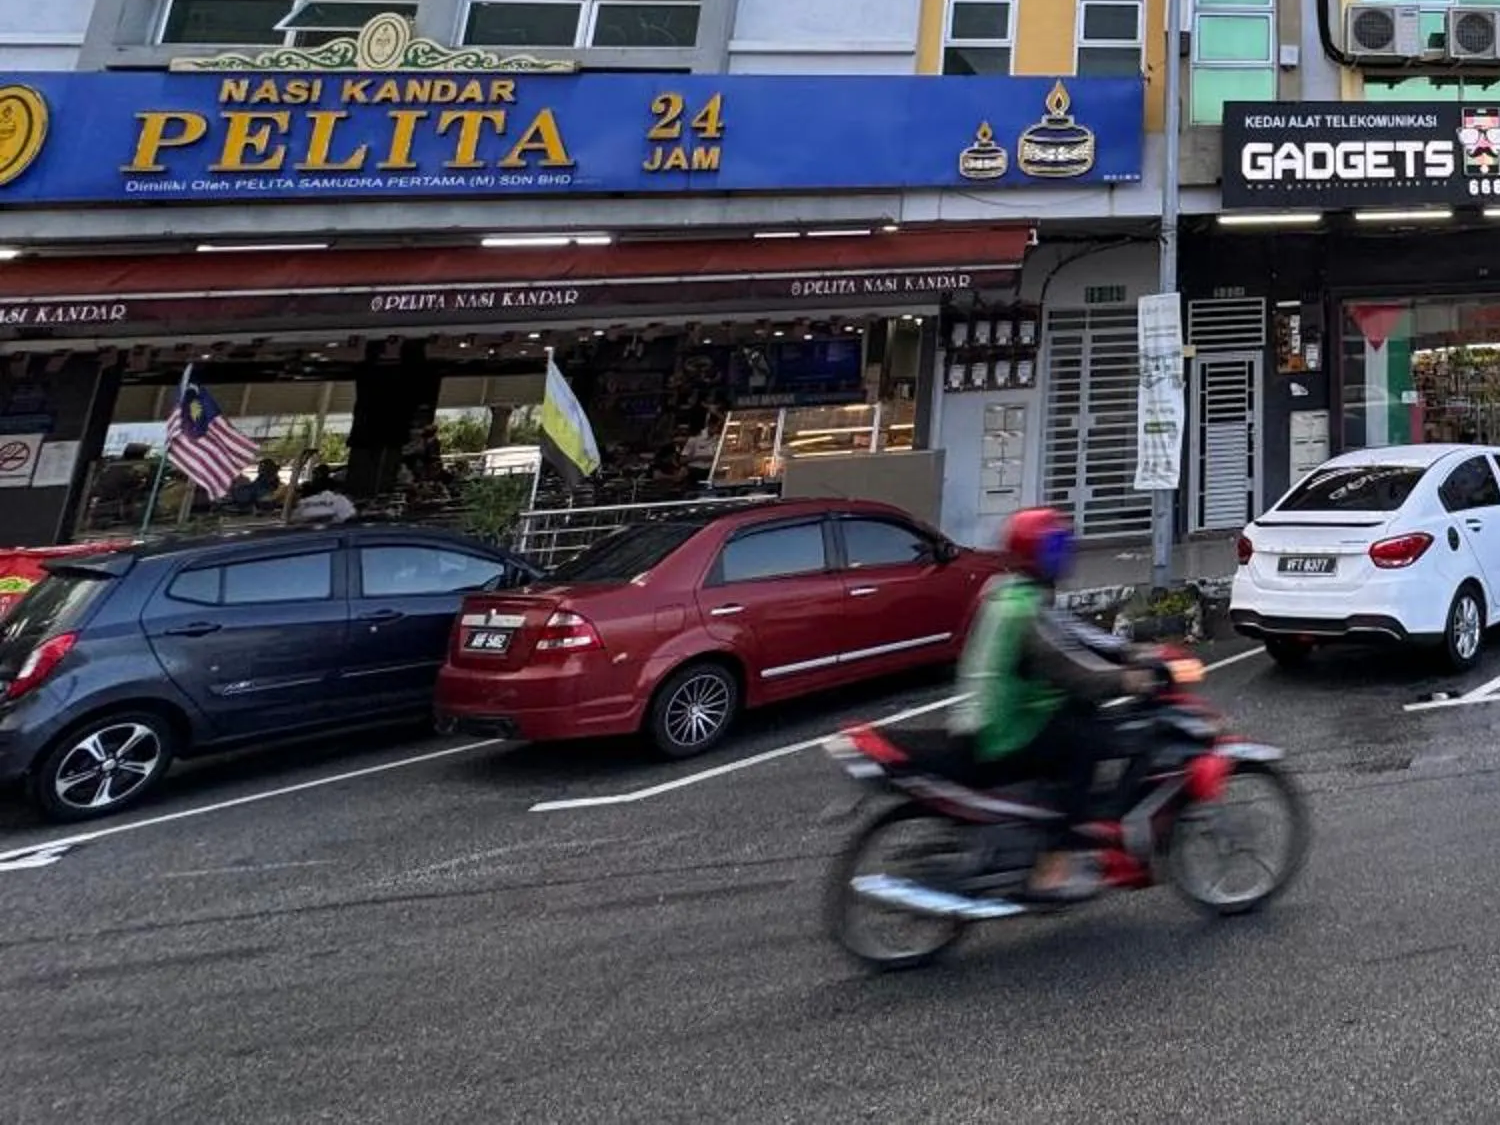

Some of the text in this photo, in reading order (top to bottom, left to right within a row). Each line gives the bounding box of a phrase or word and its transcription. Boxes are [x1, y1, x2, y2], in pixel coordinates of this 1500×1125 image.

[219, 78, 516, 103] NASI KANDAR
[646, 91, 725, 140] 24
[1244, 115, 1438, 129] KEDAI ALAT TELEKOMUNIKASI
[119, 108, 575, 173] PELITA
[643, 146, 721, 171] JAM
[1241, 140, 1455, 180] GADGETS
[125, 180, 187, 192] Dimiliki
[192, 180, 230, 191] Oleh
[235, 178, 294, 190] PELITA
[300, 177, 383, 188] SAMUDRA
[387, 176, 465, 188] PERTAMA
[470, 175, 495, 188] (M)
[500, 175, 533, 186] SDN
[538, 174, 572, 185] BHD
[803, 274, 972, 295] PELITA NASI KANDAR
[384, 289, 580, 311] PELITA NASI KANDAR
[35, 304, 128, 323] KANDAR
